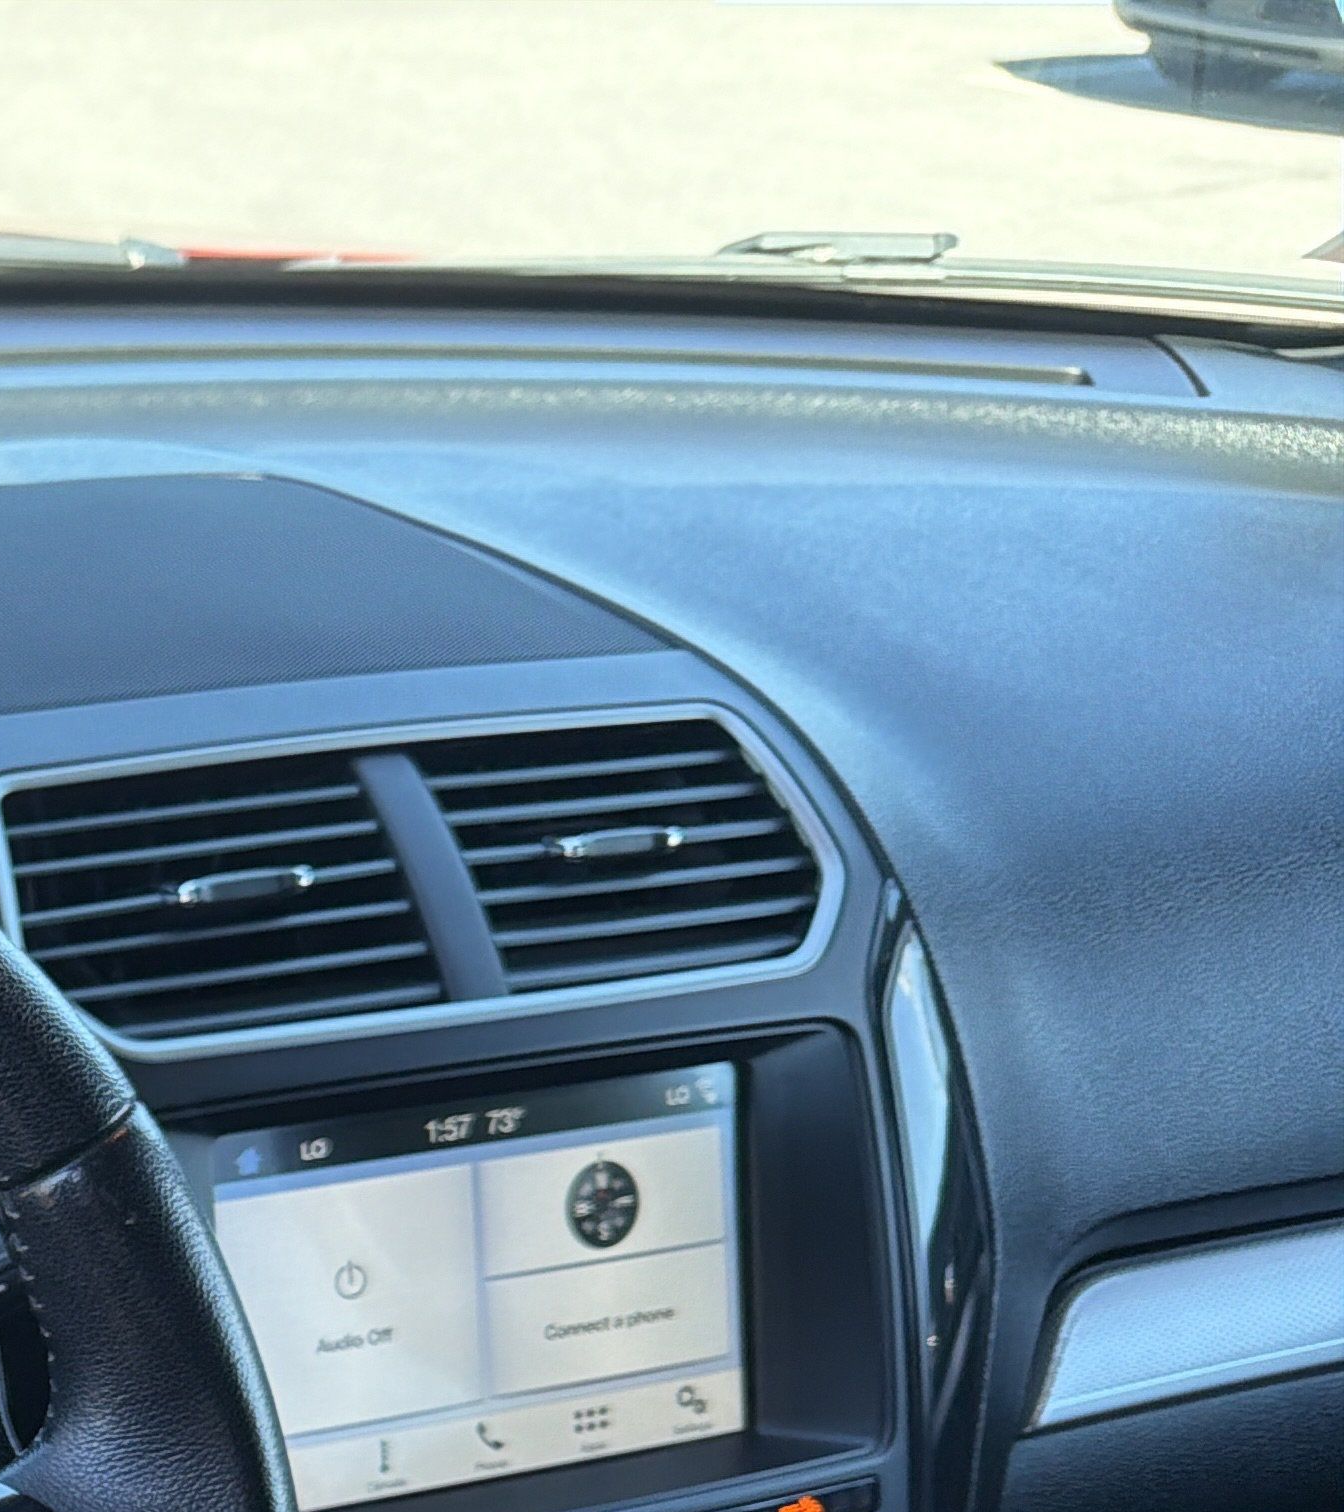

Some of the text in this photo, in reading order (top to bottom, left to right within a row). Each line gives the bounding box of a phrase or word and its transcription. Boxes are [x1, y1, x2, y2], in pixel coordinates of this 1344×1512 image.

[424, 1113, 476, 1144] 1:57
[544, 1316, 611, 1341] Connect
[627, 1307, 675, 1331] phone
[316, 1326, 395, 1354] Audio Off
